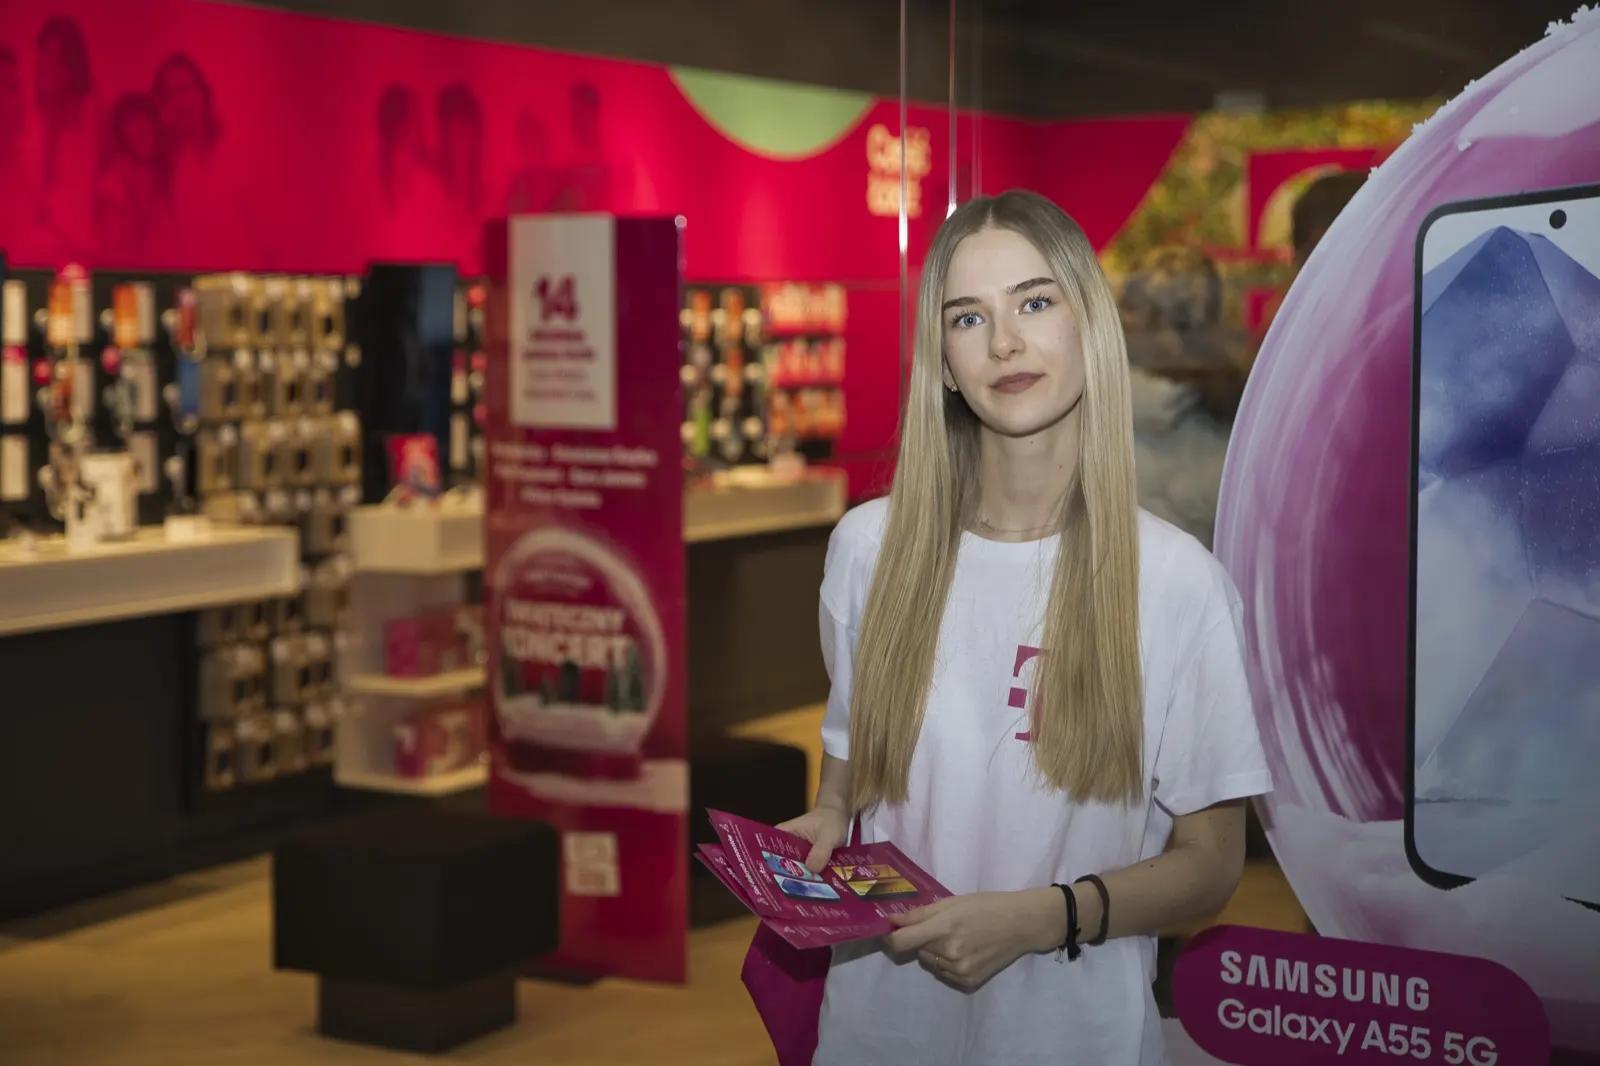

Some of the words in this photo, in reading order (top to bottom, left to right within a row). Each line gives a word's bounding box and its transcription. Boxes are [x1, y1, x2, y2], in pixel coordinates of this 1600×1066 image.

[1219, 950, 1430, 1011] SAMSUNG
[1217, 998, 1355, 1055] Galaxy
[1361, 1020, 1432, 1060] A55
[1443, 1031, 1499, 1066] 5G
